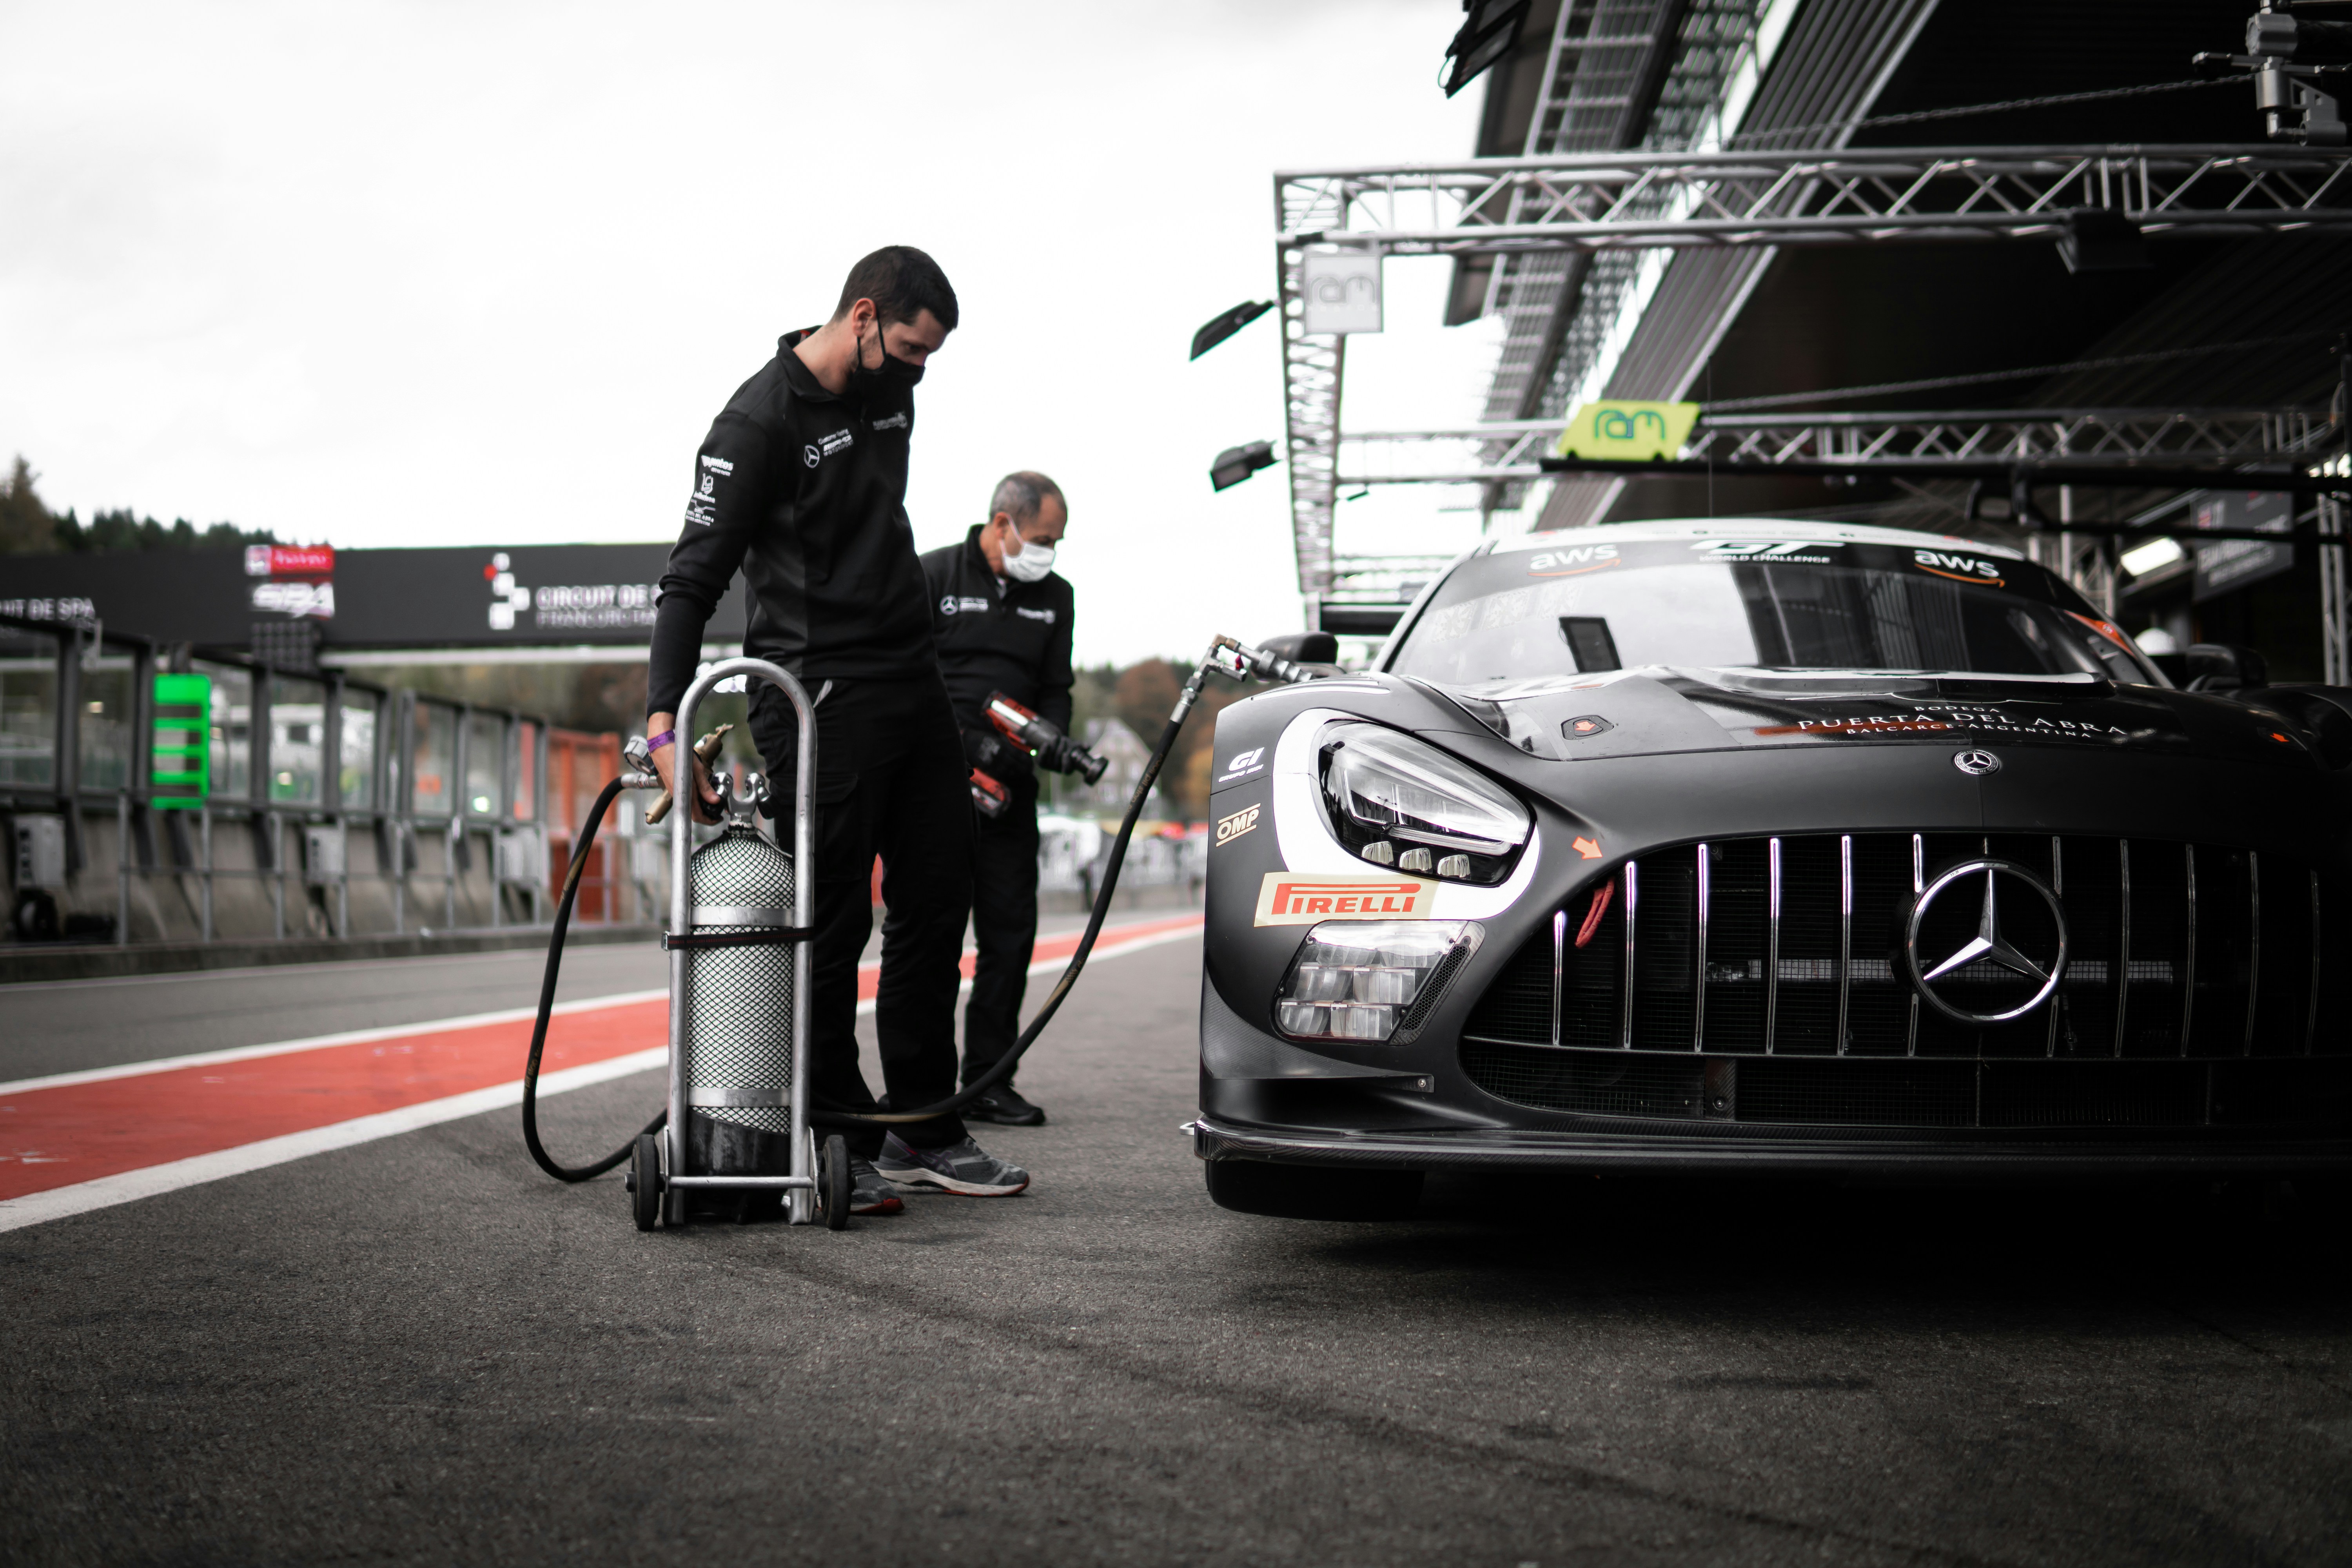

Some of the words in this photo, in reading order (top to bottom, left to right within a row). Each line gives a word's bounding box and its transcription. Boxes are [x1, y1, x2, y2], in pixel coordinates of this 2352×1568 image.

[1530, 544, 1619, 570] aws
[1752, 554, 1830, 564] CHALLENGE
[1914, 550, 1999, 577] aws
[536, 585, 617, 610] CIRCUIT
[619, 584, 648, 608] DE
[1798, 714, 1934, 730] PUERTA
[1951, 713, 2015, 724] DEL
[2032, 718, 2128, 735] ABRA
[1218, 770, 1246, 782] GRUPO
[1217, 809, 1259, 839] OMP
[1271, 884, 1421, 915] PIRELLI
